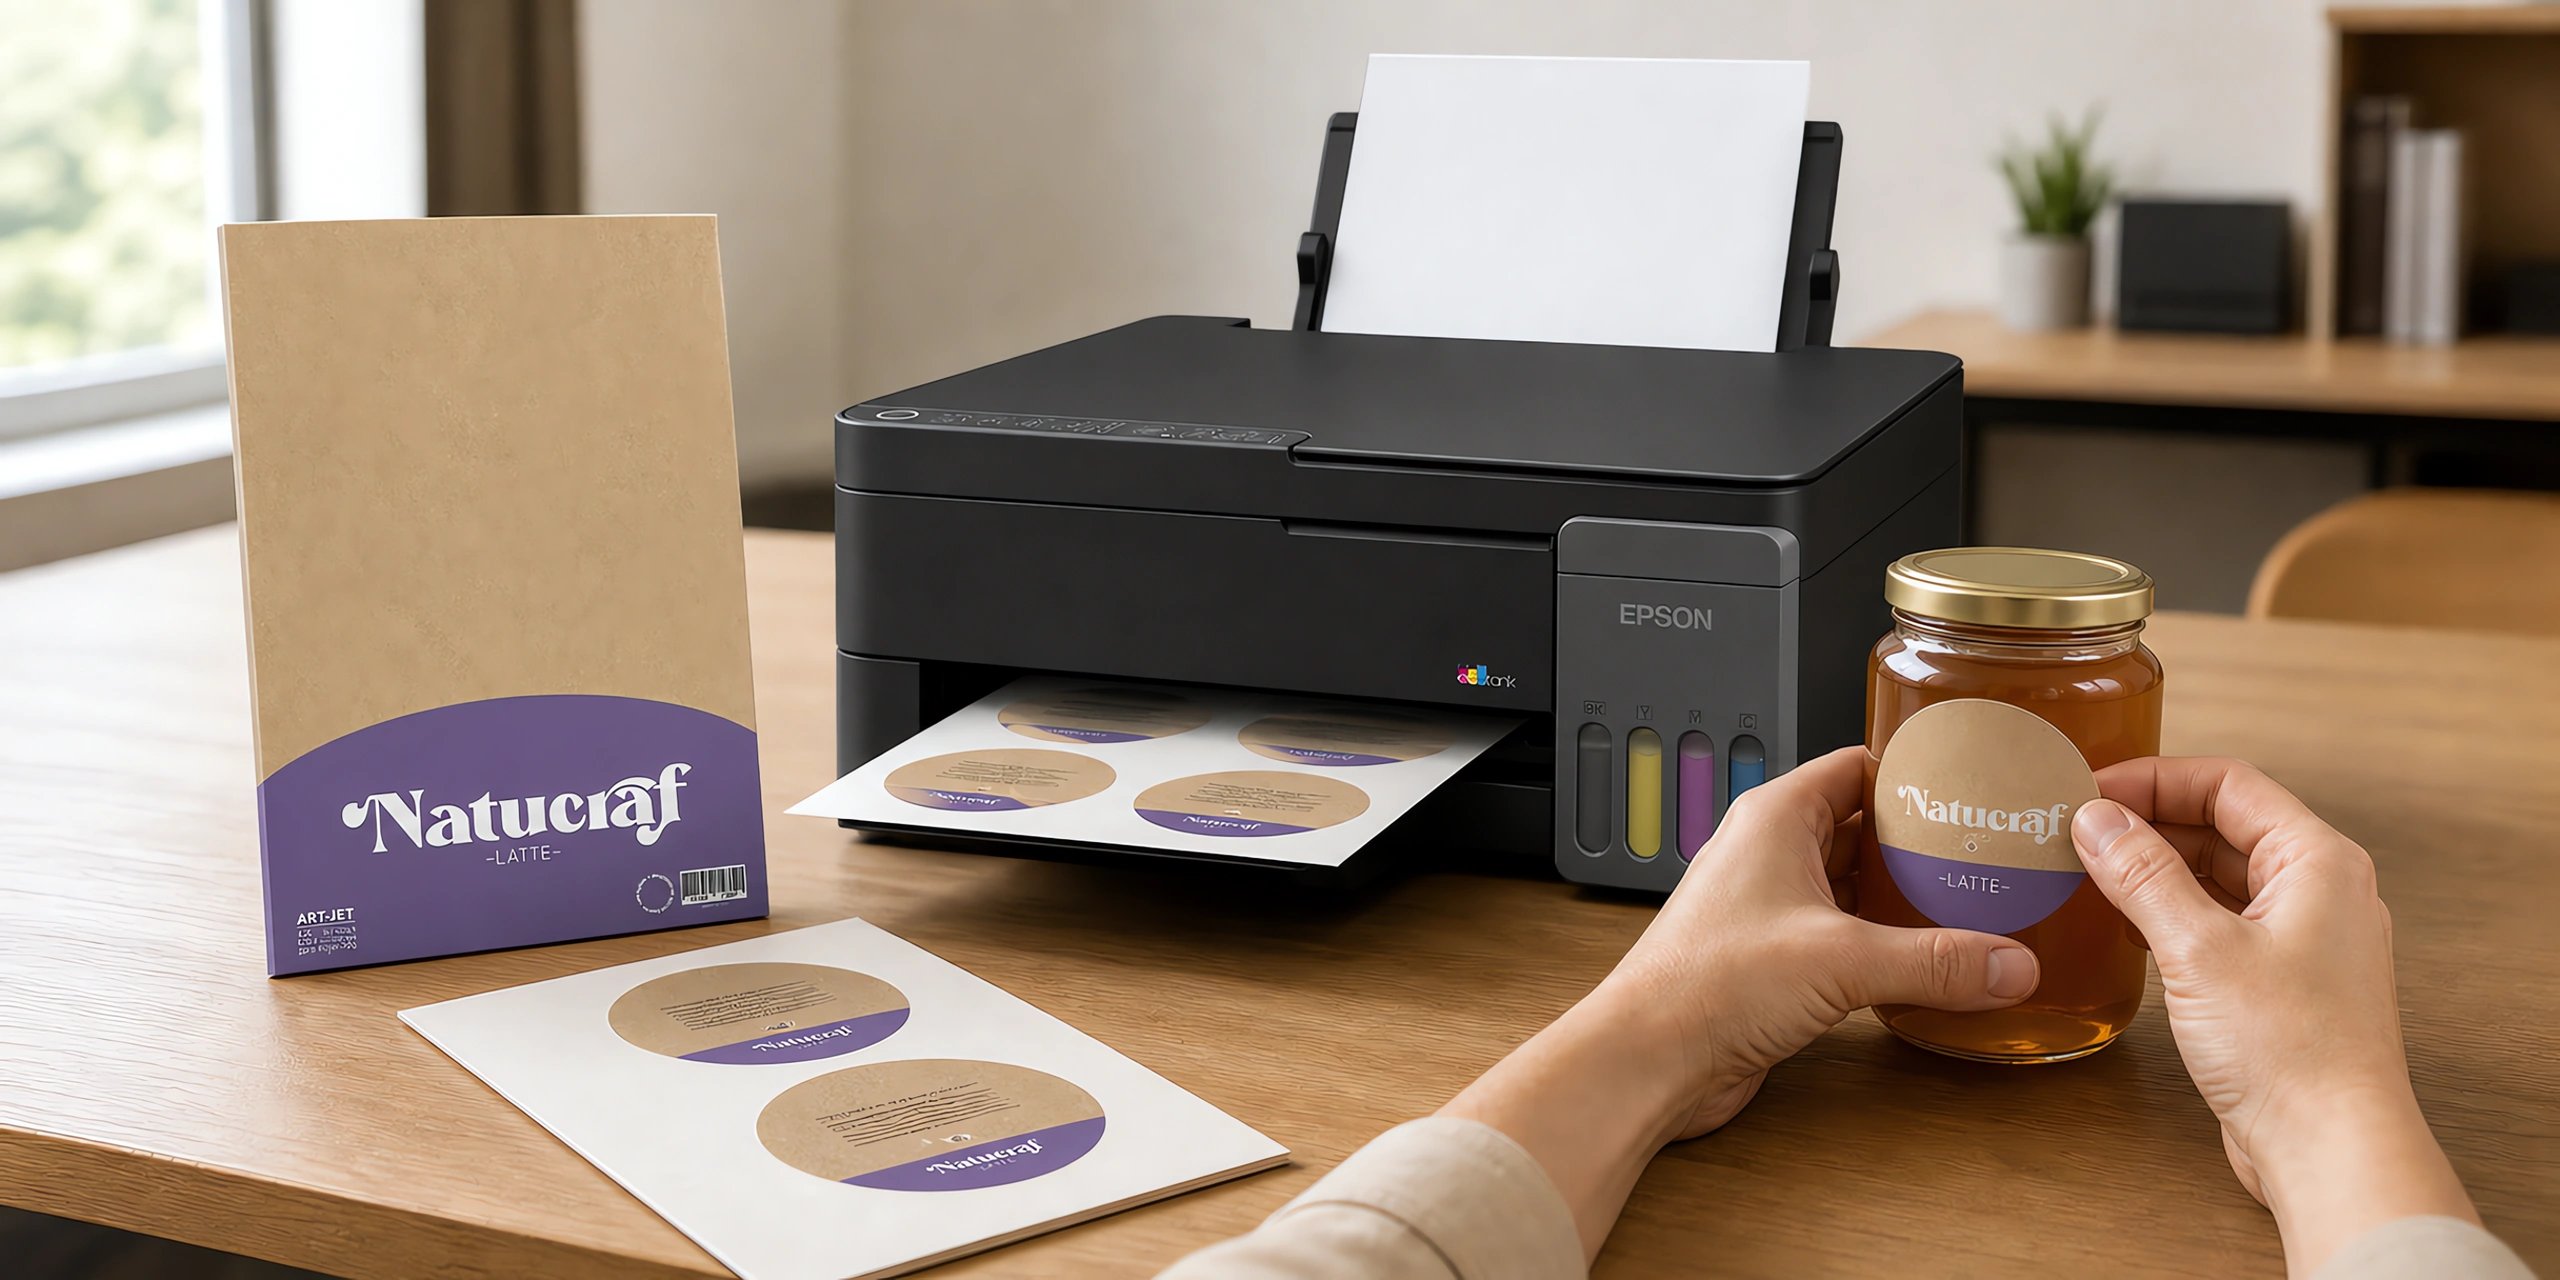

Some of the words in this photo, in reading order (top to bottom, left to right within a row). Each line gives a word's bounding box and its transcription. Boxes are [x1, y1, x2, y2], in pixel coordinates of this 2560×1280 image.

[1619, 603, 1713, 631] EPSON
[341, 762, 692, 854] Natucraf
[1897, 784, 2069, 846] Natucraf
[296, 907, 355, 926] ART-JET
